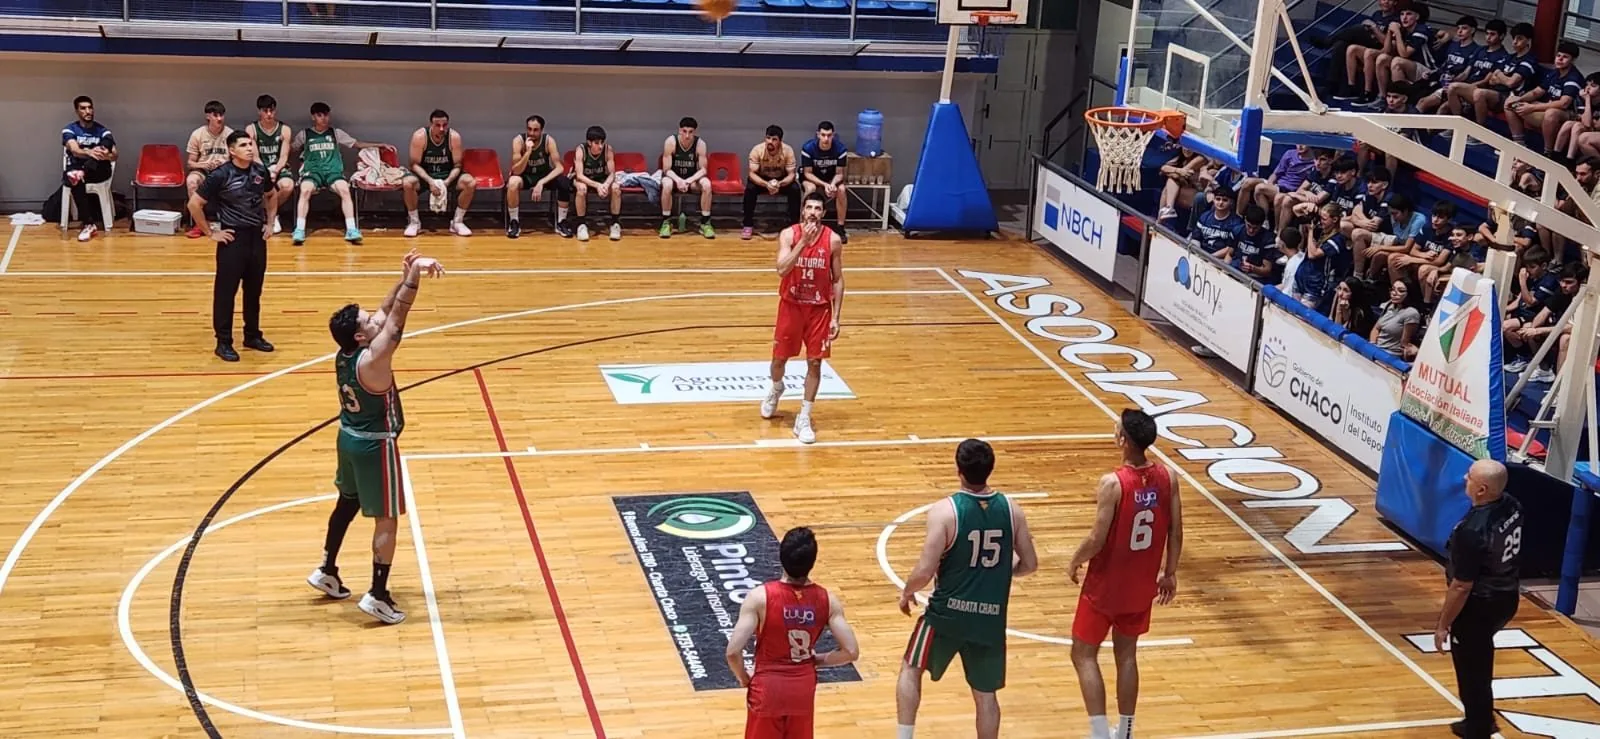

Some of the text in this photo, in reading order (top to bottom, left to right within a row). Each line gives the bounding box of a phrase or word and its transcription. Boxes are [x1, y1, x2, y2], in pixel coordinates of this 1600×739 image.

[268, 154, 277, 163] 12
[319, 151, 327, 159] 11
[1061, 202, 1103, 250] NBCH
[795, 255, 827, 269] ULTURAL
[801, 268, 815, 280] 14
[1193, 263, 1222, 316] bhy
[672, 375, 833, 385] Agroinsms
[1418, 361, 1472, 405] MUTUAL
[956, 268, 1410, 554] ASOCIACION
[1289, 376, 1343, 425] CHACO
[1350, 403, 1382, 433] Instituto
[1449, 402, 1484, 428] Italiana
[1347, 422, 1360, 438] del
[1134, 491, 1157, 506] tuya
[623, 515, 641, 537] Buenos
[1130, 509, 1154, 551] 6
[633, 537, 648, 553] Aires
[967, 528, 1004, 569] 15
[1502, 526, 1522, 564] 29
[640, 552, 658, 568] 1280
[681, 546, 710, 582] Liderazgo
[649, 571, 669, 598] Charata
[704, 543, 763, 604] Pinto
[700, 582, 719, 594] en
[660, 597, 678, 620] Chaco
[706, 593, 734, 628] insumos
[783, 605, 815, 624] tuya
[947, 597, 1000, 616] CHARATA CHACO
[788, 629, 812, 663] 8
